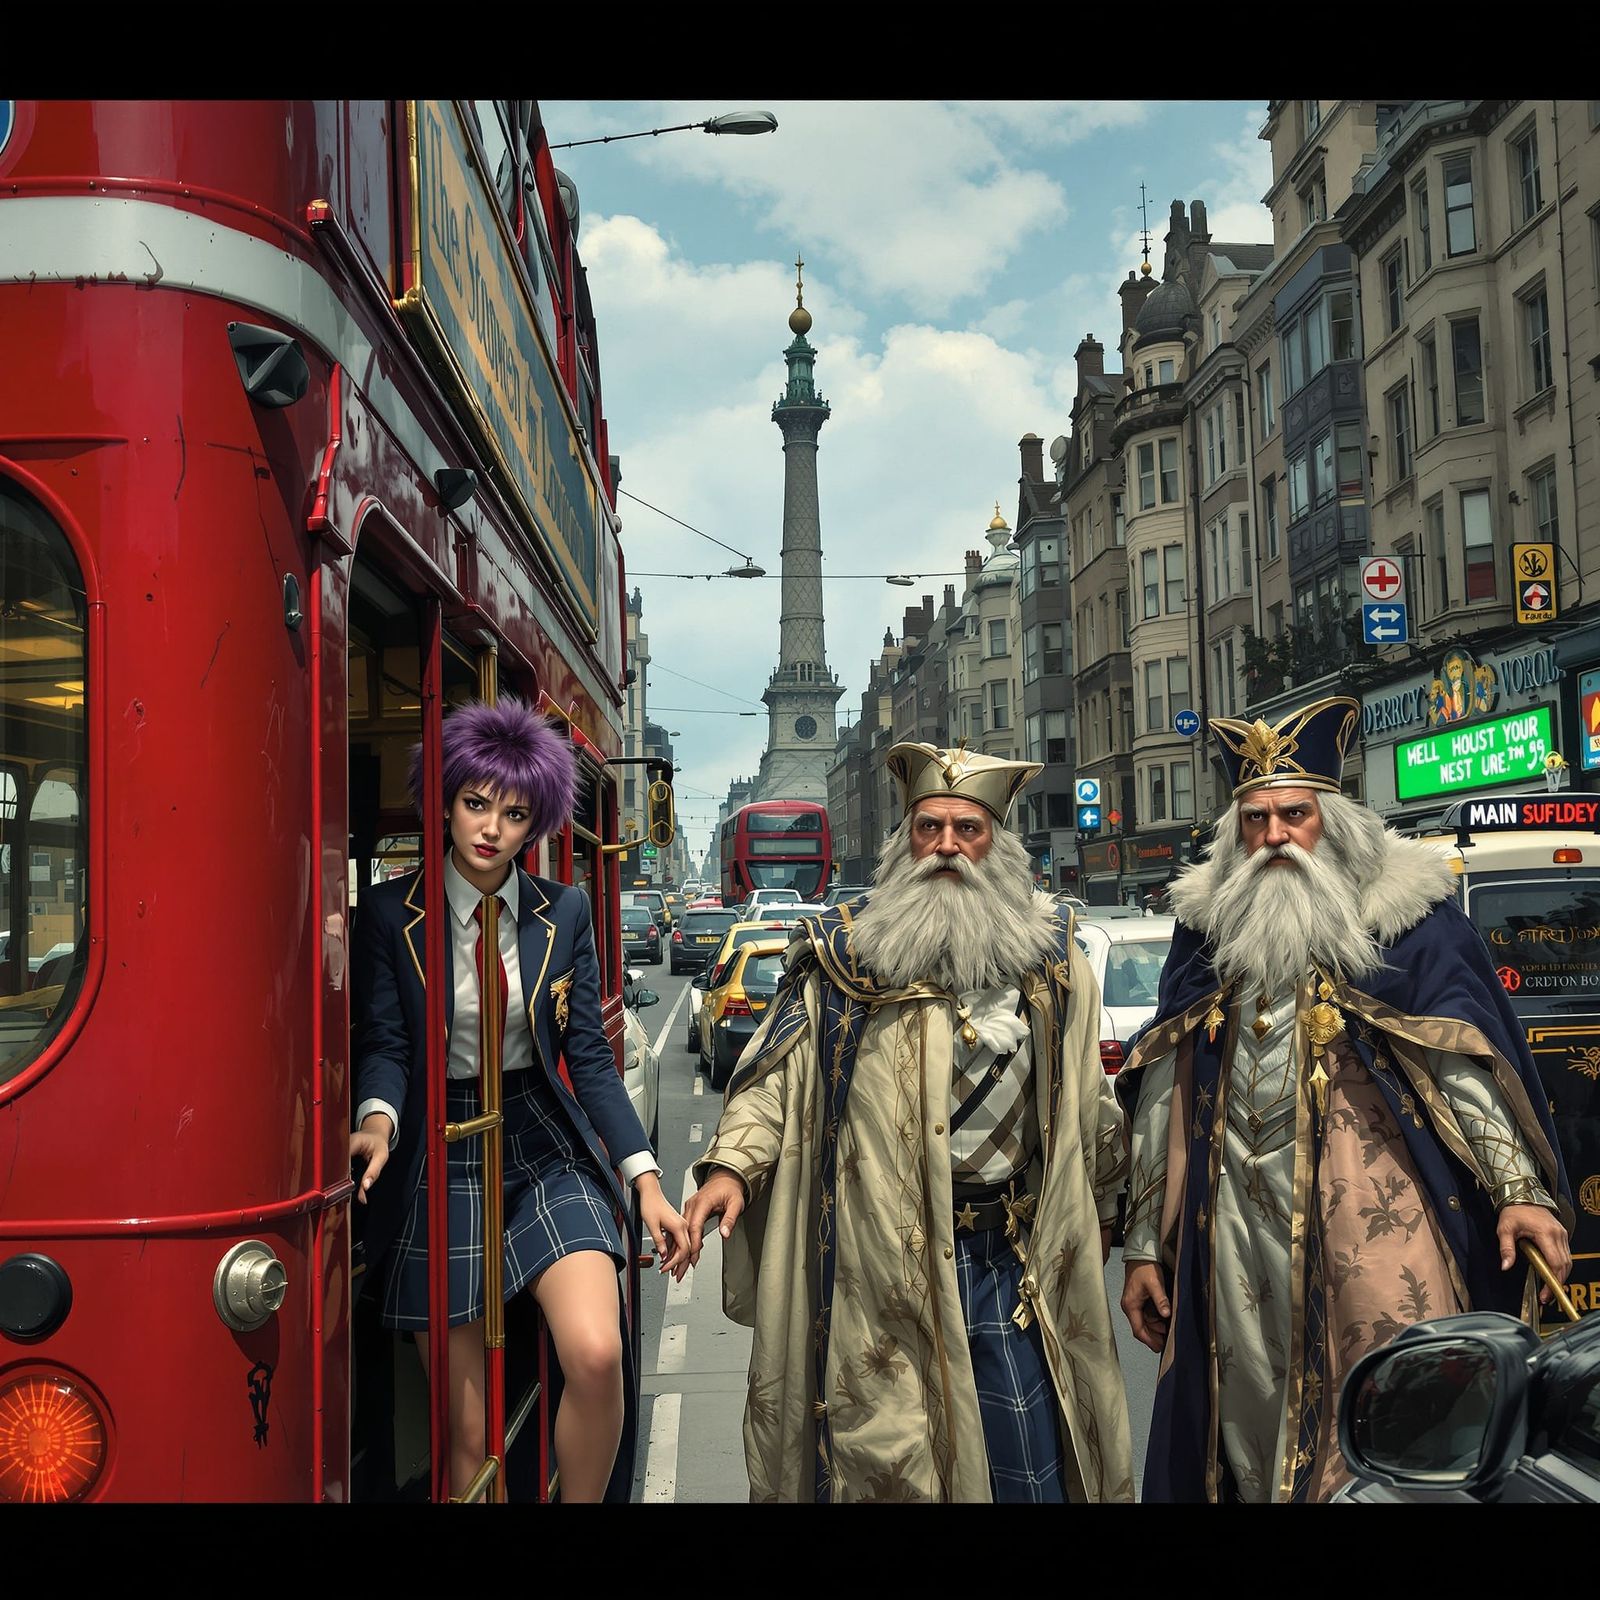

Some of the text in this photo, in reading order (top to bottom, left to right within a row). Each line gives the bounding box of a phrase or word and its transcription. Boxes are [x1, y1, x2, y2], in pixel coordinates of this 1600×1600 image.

[1502, 715, 1538, 745] YOUR
[1440, 757, 1473, 785] NEST
[1470, 802, 1599, 826] MAIN SUFLDEY
